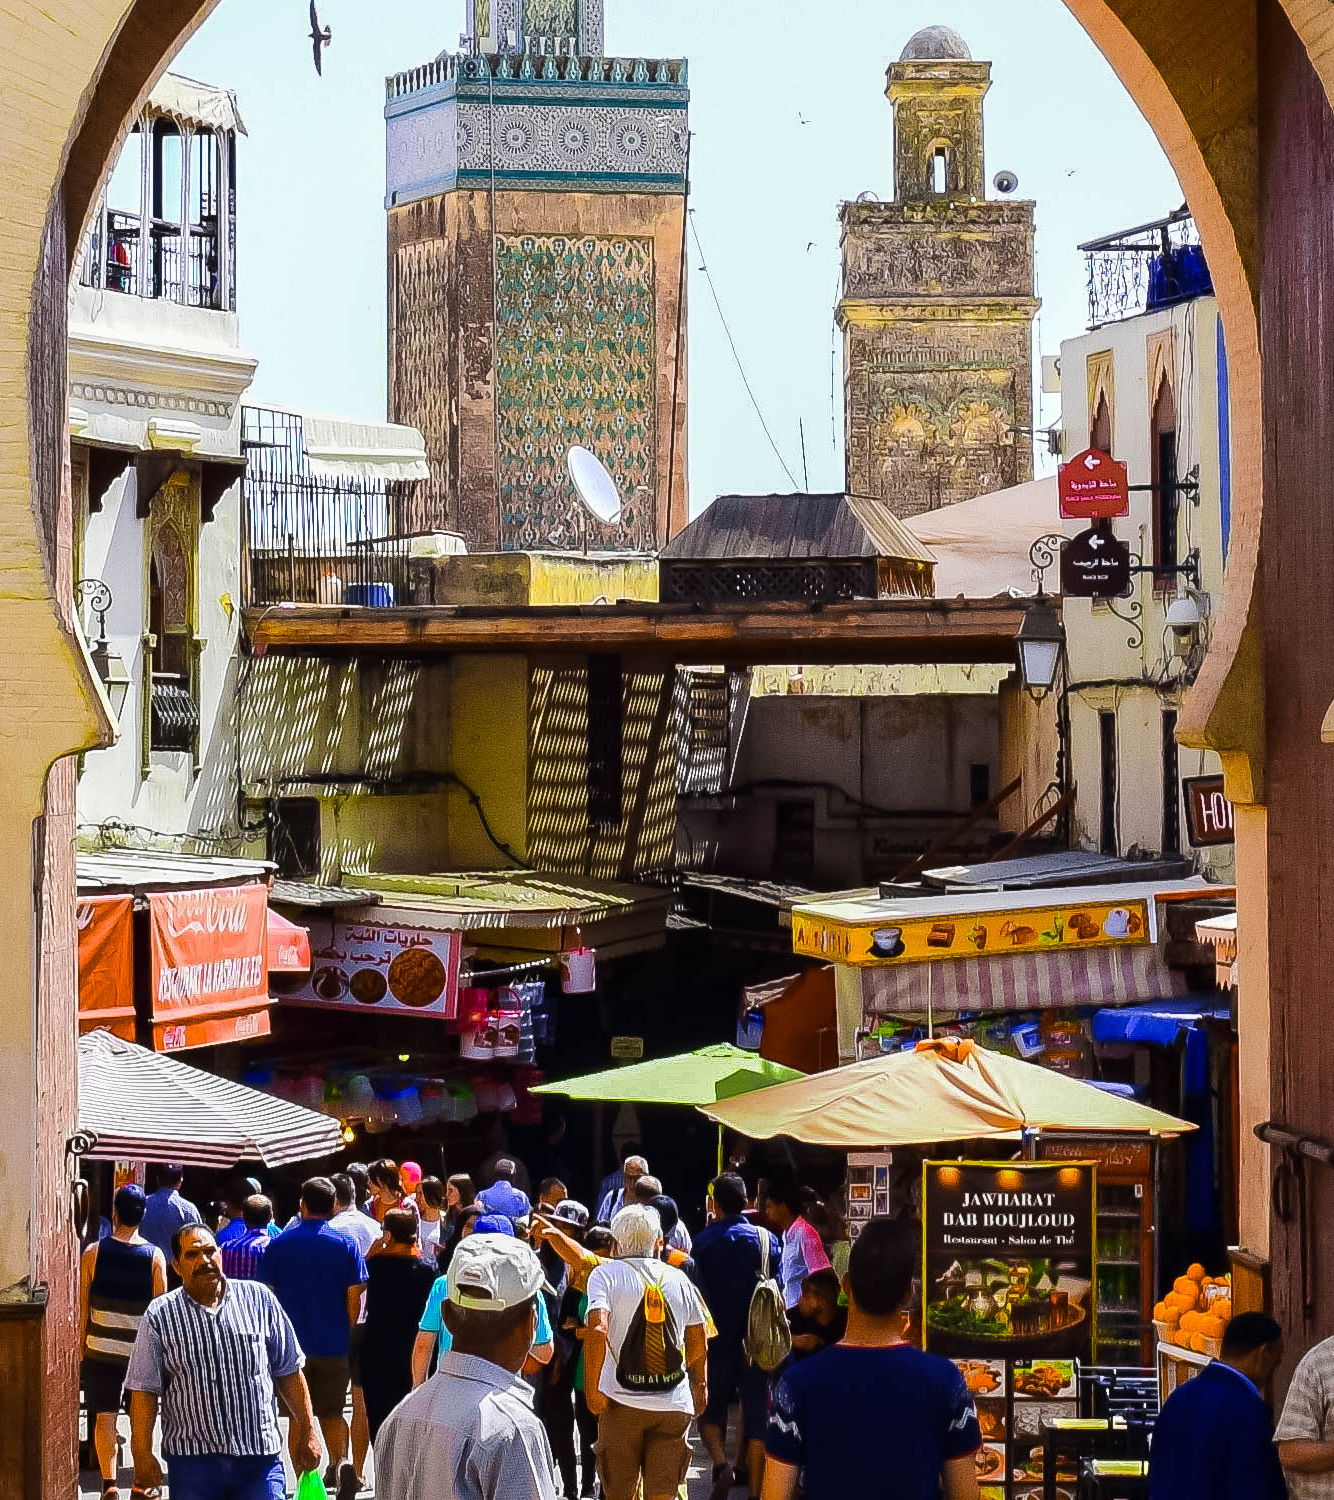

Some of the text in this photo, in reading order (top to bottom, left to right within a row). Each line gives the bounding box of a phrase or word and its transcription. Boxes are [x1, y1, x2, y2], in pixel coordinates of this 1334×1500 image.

[962, 1192, 1056, 1207] JAWHARAT
[943, 1212, 1075, 1228] BAB BOUJLOUD
[943, 1234, 998, 1245] Restaurant
[1039, 1235, 1052, 1245] de
